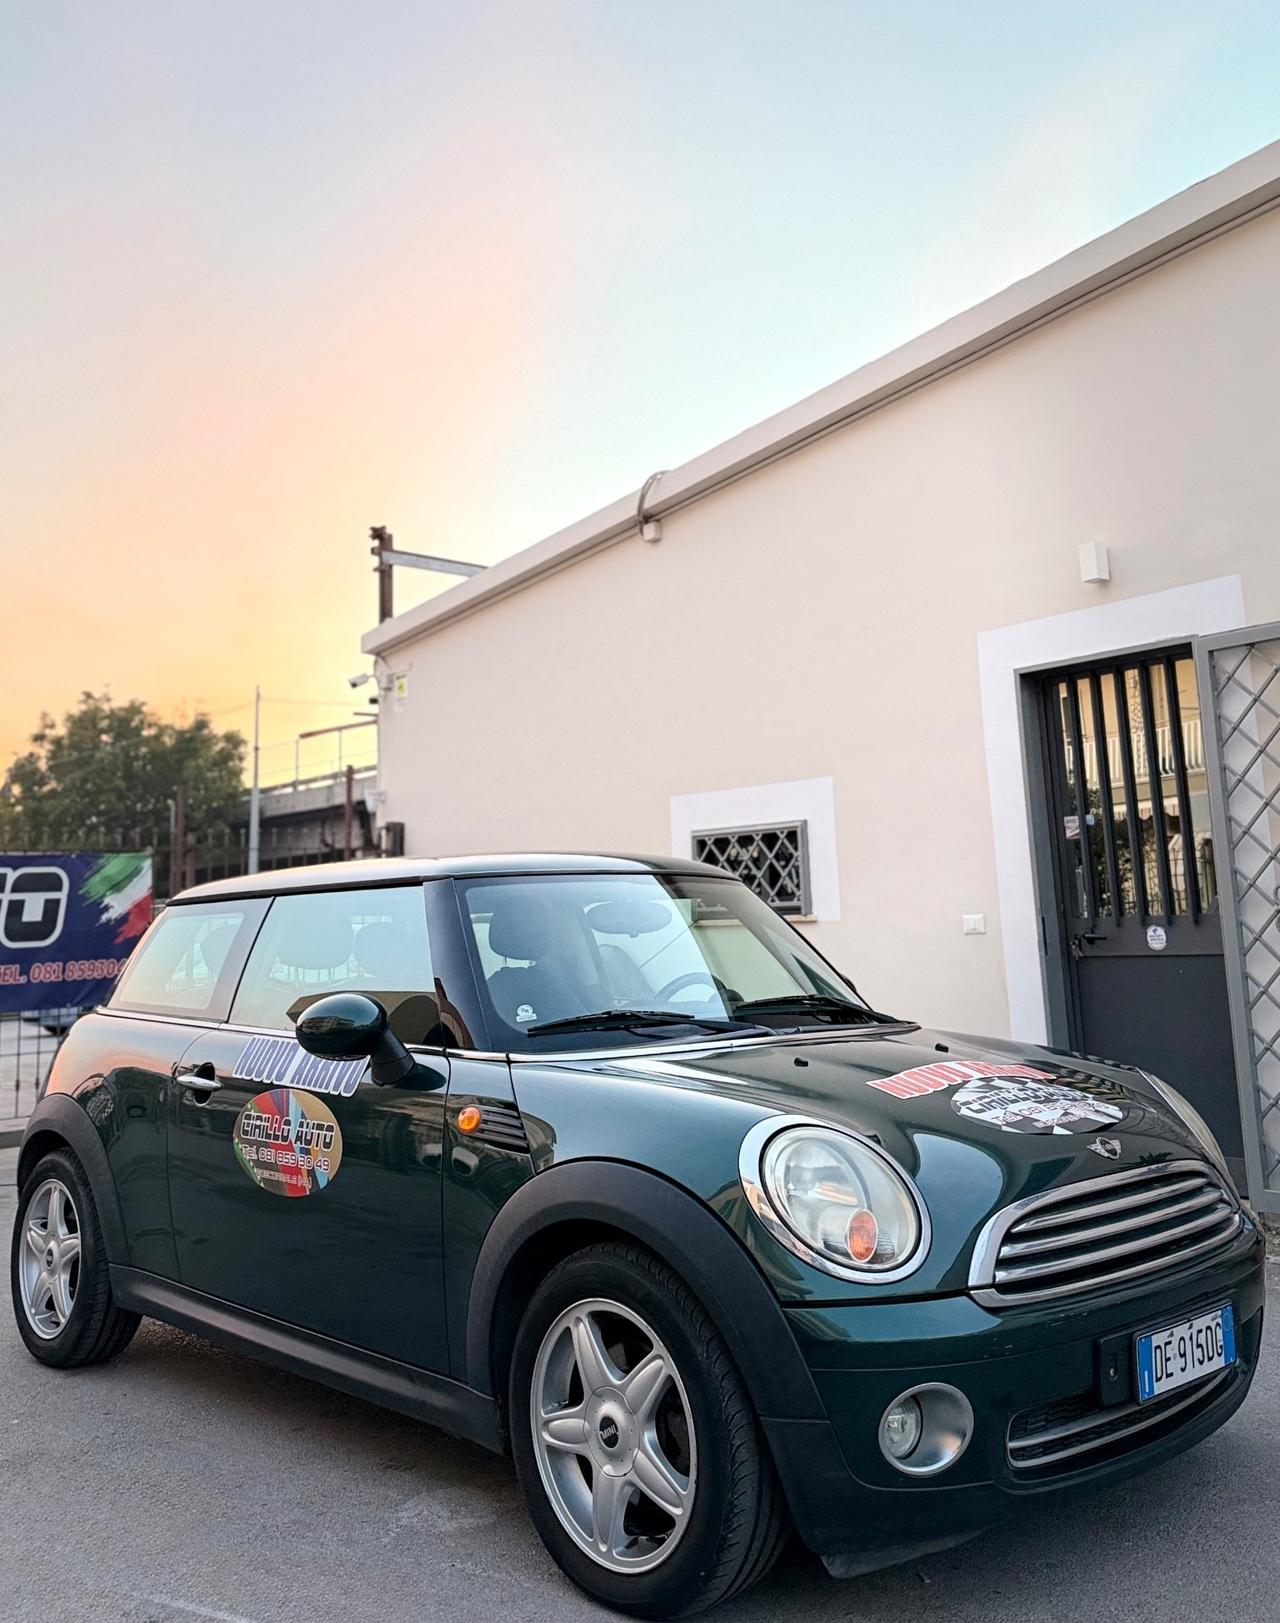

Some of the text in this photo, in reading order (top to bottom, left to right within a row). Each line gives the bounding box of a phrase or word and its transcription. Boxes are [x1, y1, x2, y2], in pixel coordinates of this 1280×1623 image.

[0, 866, 69, 948] O
[0, 965, 27, 984] EL.
[30, 962, 63, 983] 081
[233, 1037, 300, 1083] NUOVO
[867, 1062, 975, 1098] NUOVO
[240, 1112, 335, 1151] CIRILLO AUTO
[259, 1147, 276, 1163] 081
[277, 1151, 298, 1167] 859
[315, 1157, 331, 1173] 49
[602, 1424, 618, 1440] MINI
